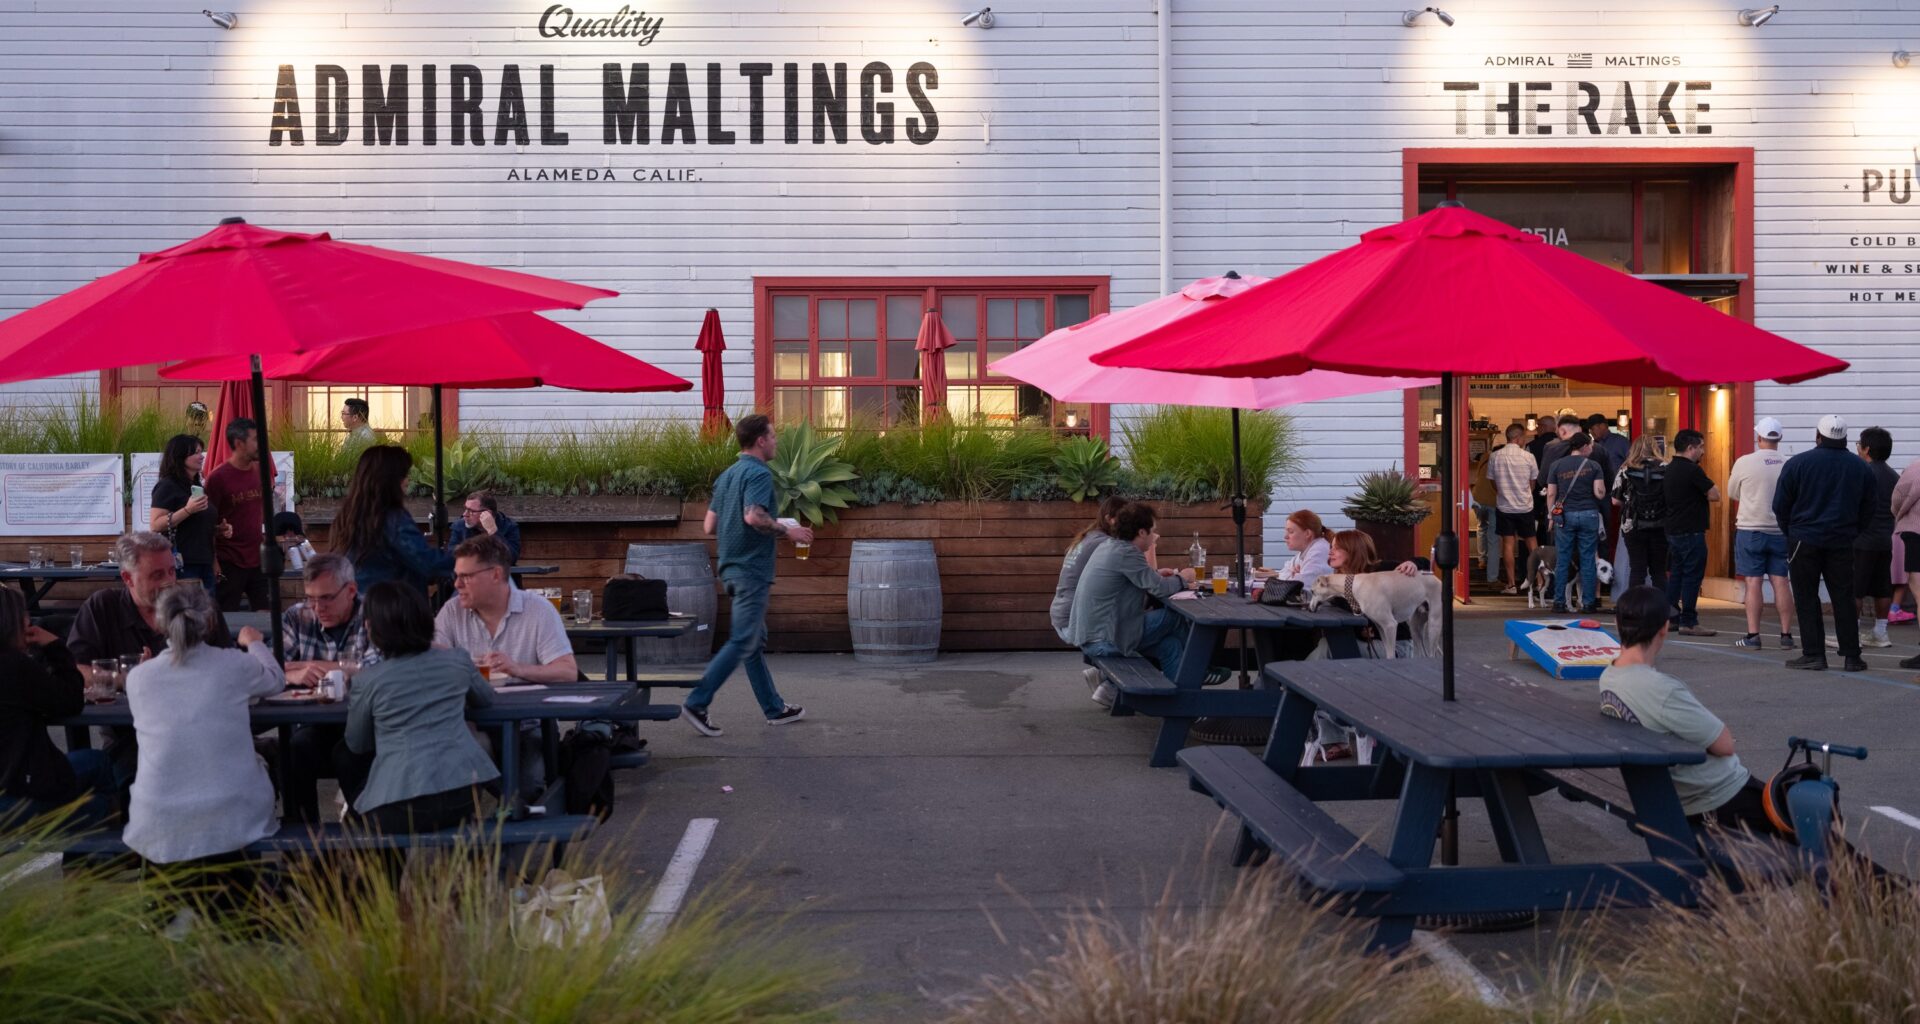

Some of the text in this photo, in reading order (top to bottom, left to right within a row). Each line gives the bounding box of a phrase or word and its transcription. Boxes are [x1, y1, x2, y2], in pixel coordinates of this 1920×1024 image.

[538, 3, 664, 47] Quality
[1484, 55, 1555, 67] ADMIRAL
[1605, 55, 1681, 67] MALTINGS
[269, 61, 940, 146] ADMIRAL MALTINGS
[1443, 81, 1712, 135] THE RAKE
[507, 168, 705, 182] ALAMEDA CALIF.
[1850, 237, 1896, 246] COLD
[1826, 264, 1870, 273] WINE
[1881, 264, 1893, 273] &
[1850, 292, 1884, 301] HOT
[19, 462, 26, 471] OF
[28, 462, 64, 471] CALIFORNIA
[66, 461, 90, 471] BARLEY
